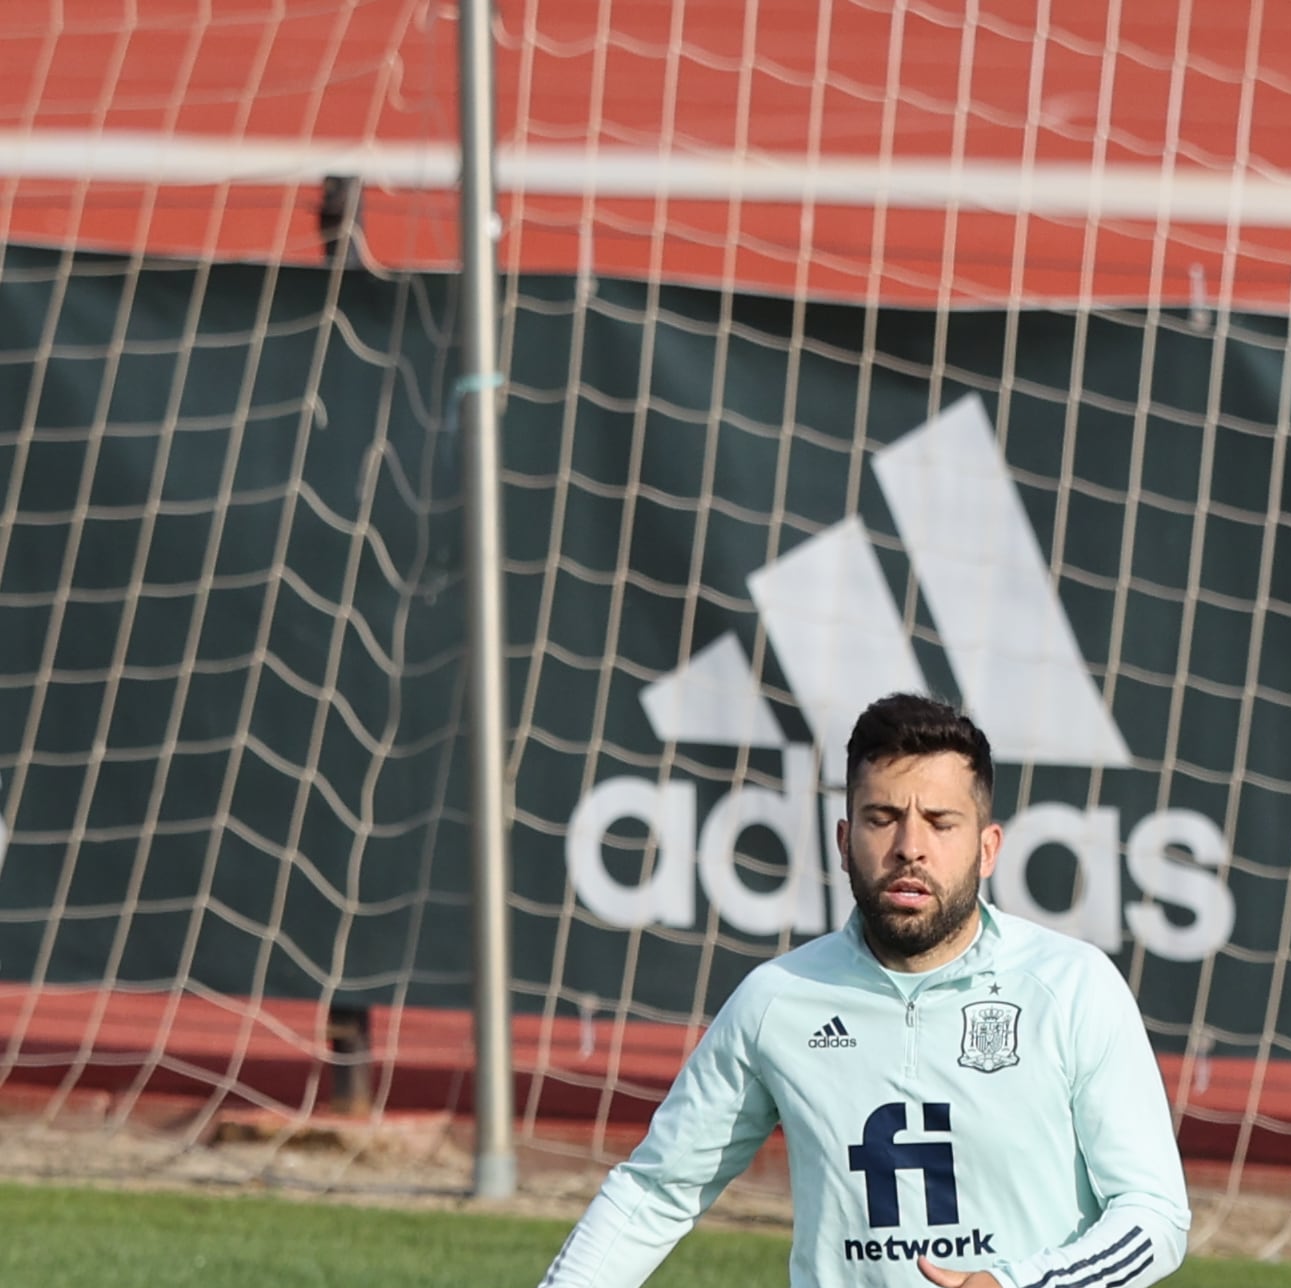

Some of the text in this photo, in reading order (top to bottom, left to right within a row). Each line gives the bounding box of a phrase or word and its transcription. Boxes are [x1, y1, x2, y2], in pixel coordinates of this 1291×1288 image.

[564, 745, 1235, 963] adias
[808, 1036, 857, 1049] adidas
[848, 1102, 960, 1228] fi
[844, 1228, 997, 1261] network
